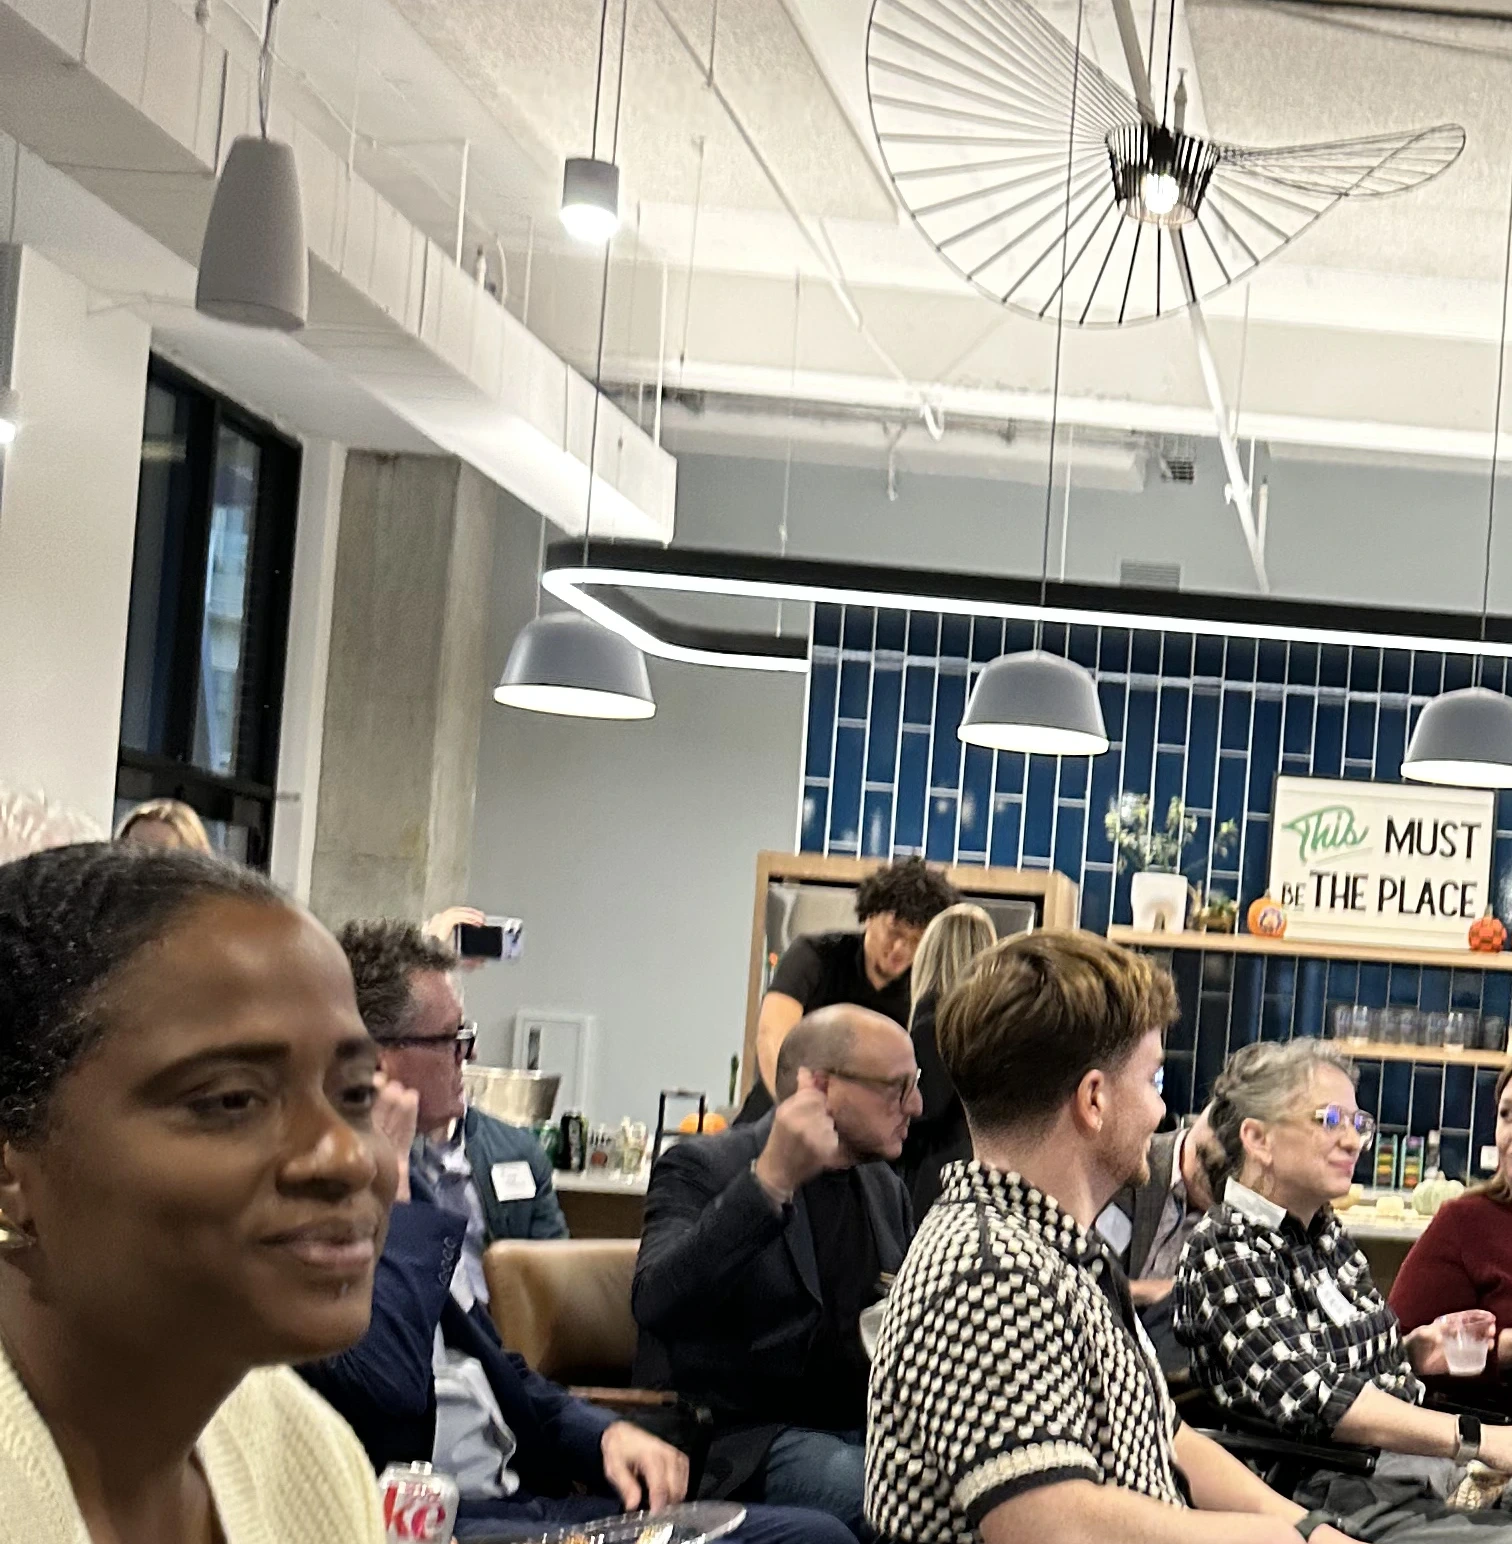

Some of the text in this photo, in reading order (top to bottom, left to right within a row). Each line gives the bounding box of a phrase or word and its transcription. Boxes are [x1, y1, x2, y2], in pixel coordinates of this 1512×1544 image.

[1281, 805, 1482, 864] This MUST
[1281, 869, 1478, 919] BE THE PLACE
